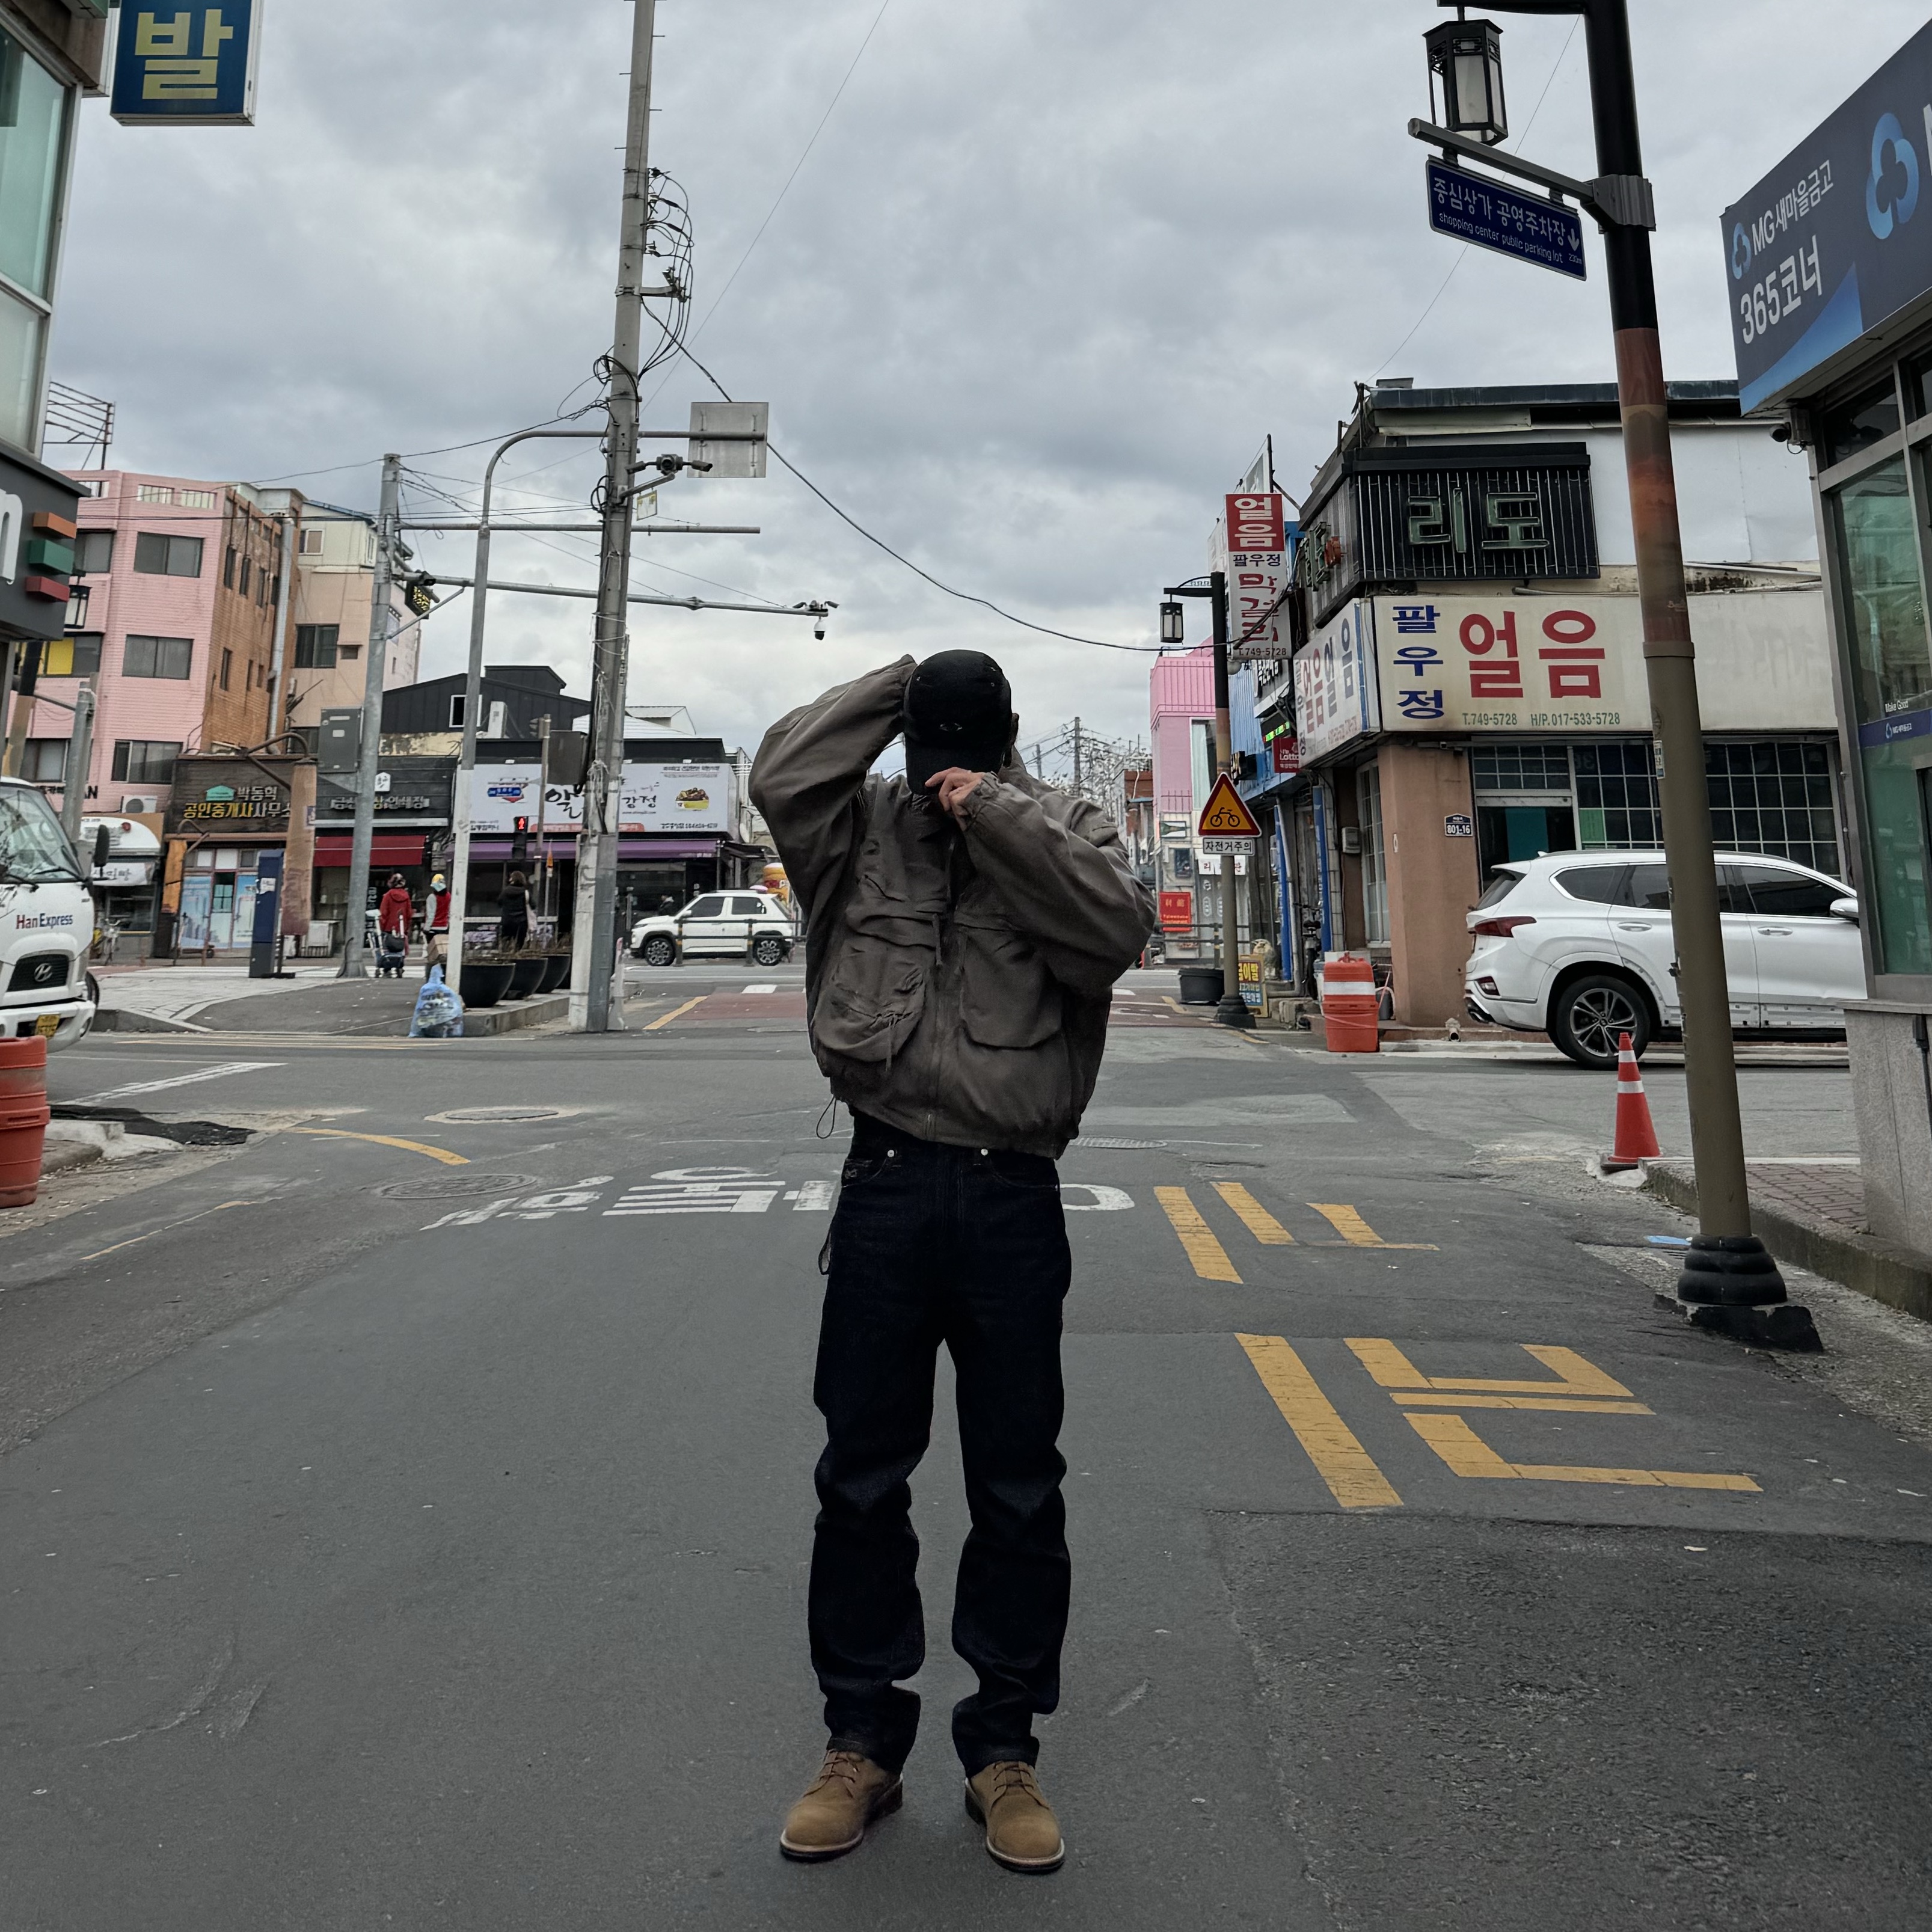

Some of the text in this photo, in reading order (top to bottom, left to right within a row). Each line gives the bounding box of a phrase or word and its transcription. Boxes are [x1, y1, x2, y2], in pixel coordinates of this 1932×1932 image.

[135, 8, 233, 100] 발
[1434, 177, 1566, 247] 중심상가 공영주차장
[1439, 212, 1563, 263] shopping center public parking lot
[1740, 234, 1823, 345] 365코너
[1234, 497, 1277, 548] 얼음
[1408, 488, 1550, 553] 리도
[1233, 554, 1281, 567] 팔우정
[1238, 573, 1280, 643] 막걸리
[1238, 647, 1287, 657] T.749-5728
[1392, 605, 1445, 720] 팔우정
[1459, 610, 1605, 699] 얼음
[1462, 712, 1518, 726] T.749-5728
[1205, 841, 1252, 852] 자전거주의
[1447, 824, 1471, 834] 801-16
